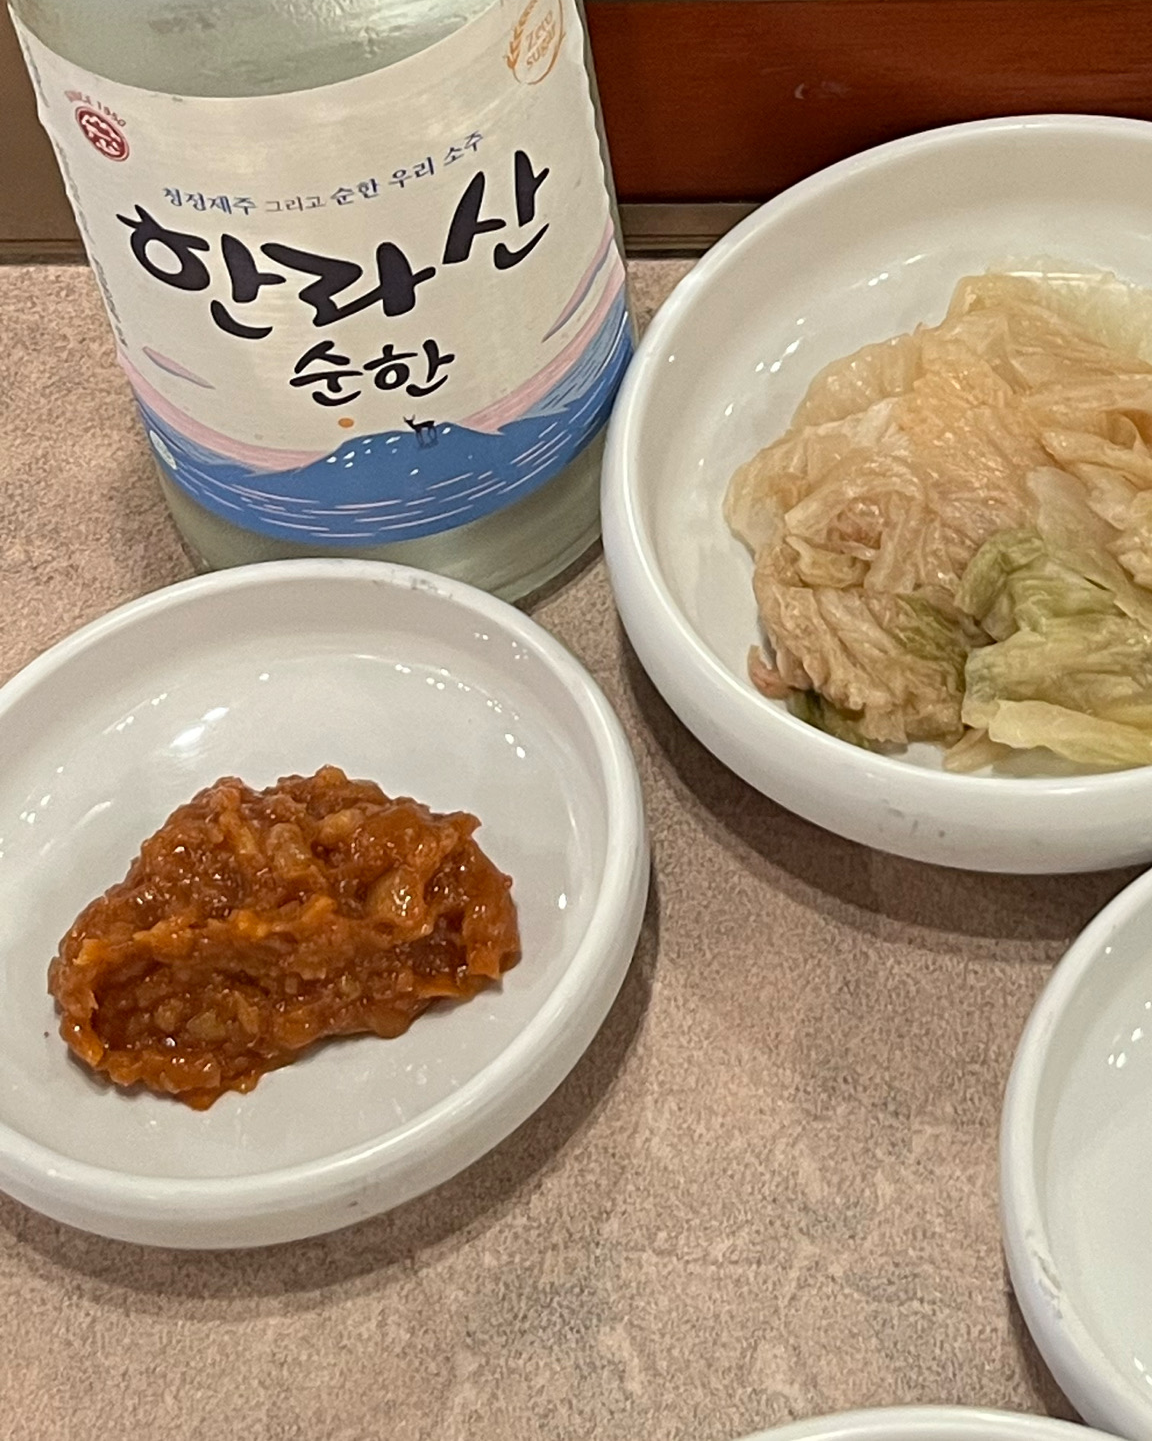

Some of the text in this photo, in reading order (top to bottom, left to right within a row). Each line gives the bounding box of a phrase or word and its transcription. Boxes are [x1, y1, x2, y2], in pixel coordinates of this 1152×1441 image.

[265, 196, 327, 214] 그리고
[330, 177, 380, 207] 순한
[388, 156, 435, 189] 우리
[444, 130, 483, 167] 소주
[116, 150, 550, 340] 한라산
[290, 339, 456, 407] 순한
